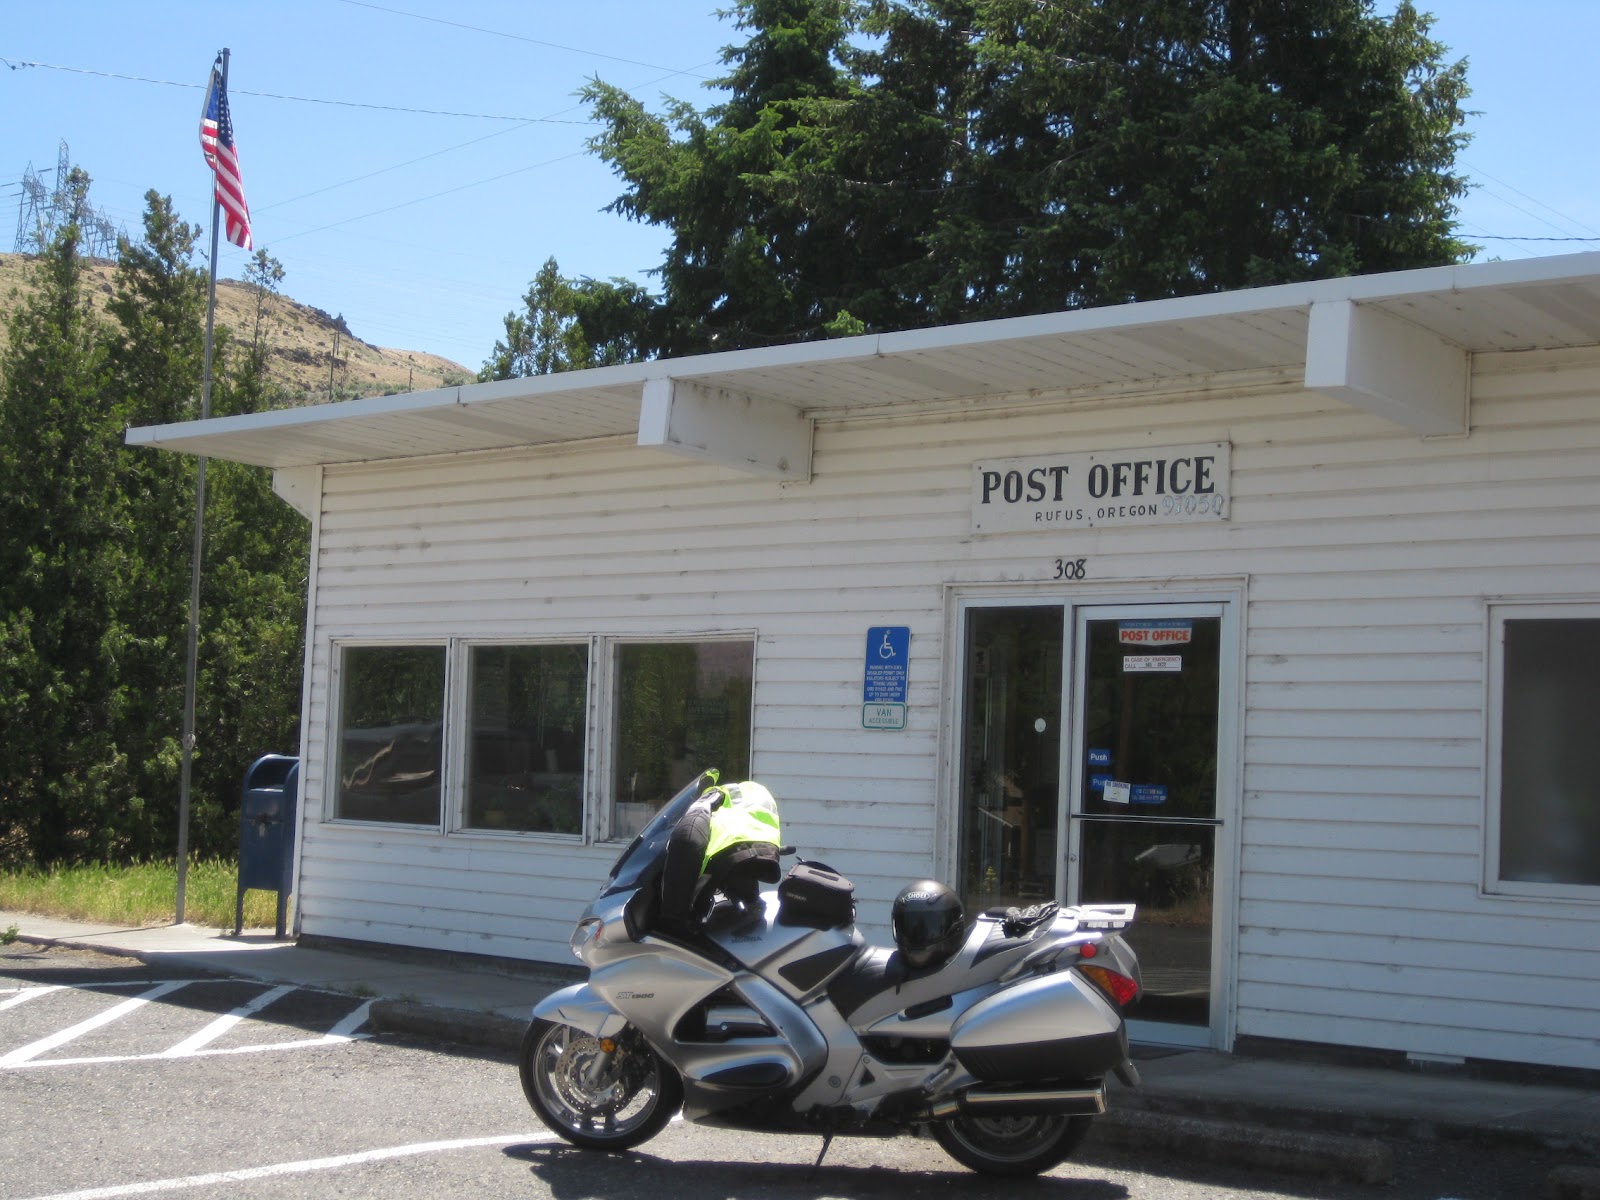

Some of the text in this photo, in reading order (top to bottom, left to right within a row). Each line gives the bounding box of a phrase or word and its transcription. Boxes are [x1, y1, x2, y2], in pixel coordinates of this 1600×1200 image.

[981, 456, 1215, 504] POST OFFICE
[1035, 509, 1092, 522] RUFUS,
[1097, 504, 1157, 518] OREGON
[1053, 558, 1087, 580] 308
[1121, 630, 1189, 641] POST OFFICE
[876, 708, 892, 717] VAN
[1090, 753, 1108, 761] Push
[1093, 778, 1107, 786] Pus
